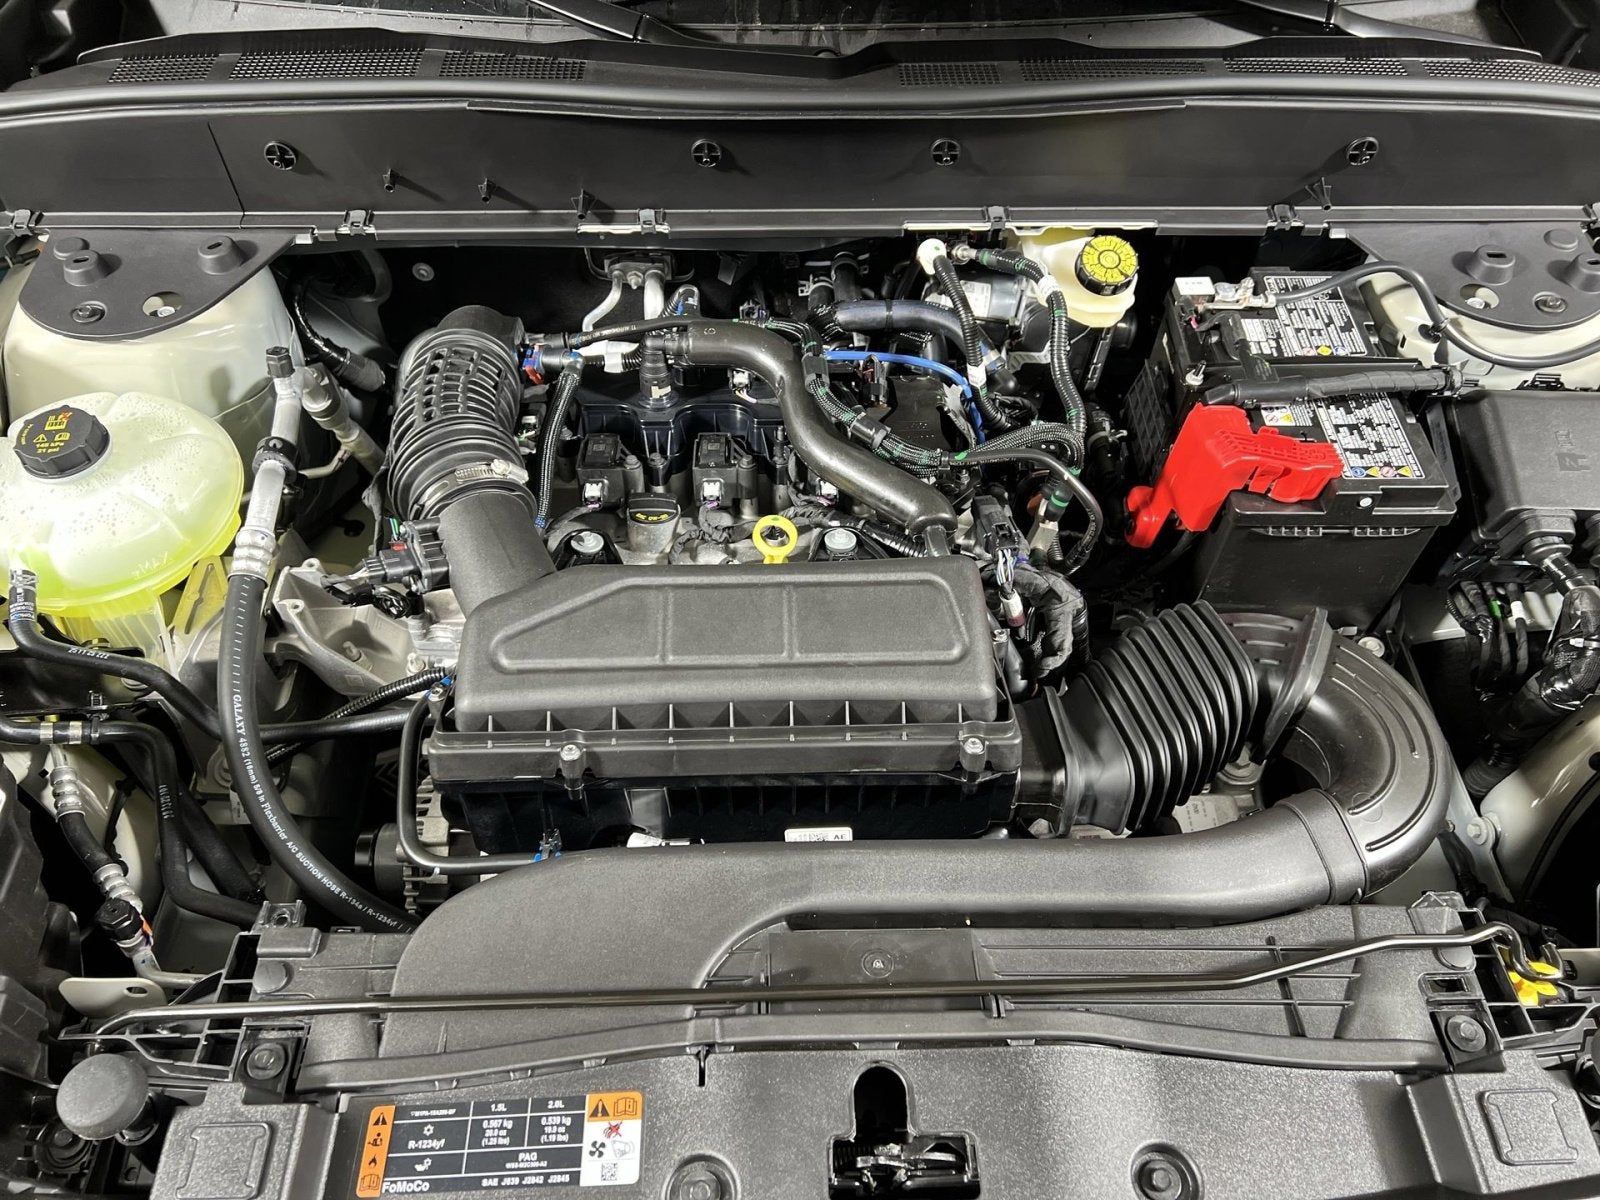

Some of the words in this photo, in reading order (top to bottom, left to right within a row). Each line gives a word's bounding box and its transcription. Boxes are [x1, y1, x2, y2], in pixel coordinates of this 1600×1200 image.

[233, 694, 246, 736] GALAXY
[238, 737, 250, 758] 4882
[261, 802, 288, 840] Flexbarrier
[286, 841, 298, 854] A/C
[296, 852, 324, 880] SUCTION
[321, 876, 341, 895] HOSE
[548, 1100, 564, 1109] 2.0L
[503, 1119, 513, 1129] kg
[562, 1116, 571, 1126] kg
[408, 1138, 446, 1150] R-1234yf
[518, 1152, 538, 1161] PAG
[382, 1179, 430, 1194] FoMoCo
[481, 1178, 498, 1187] SAE
